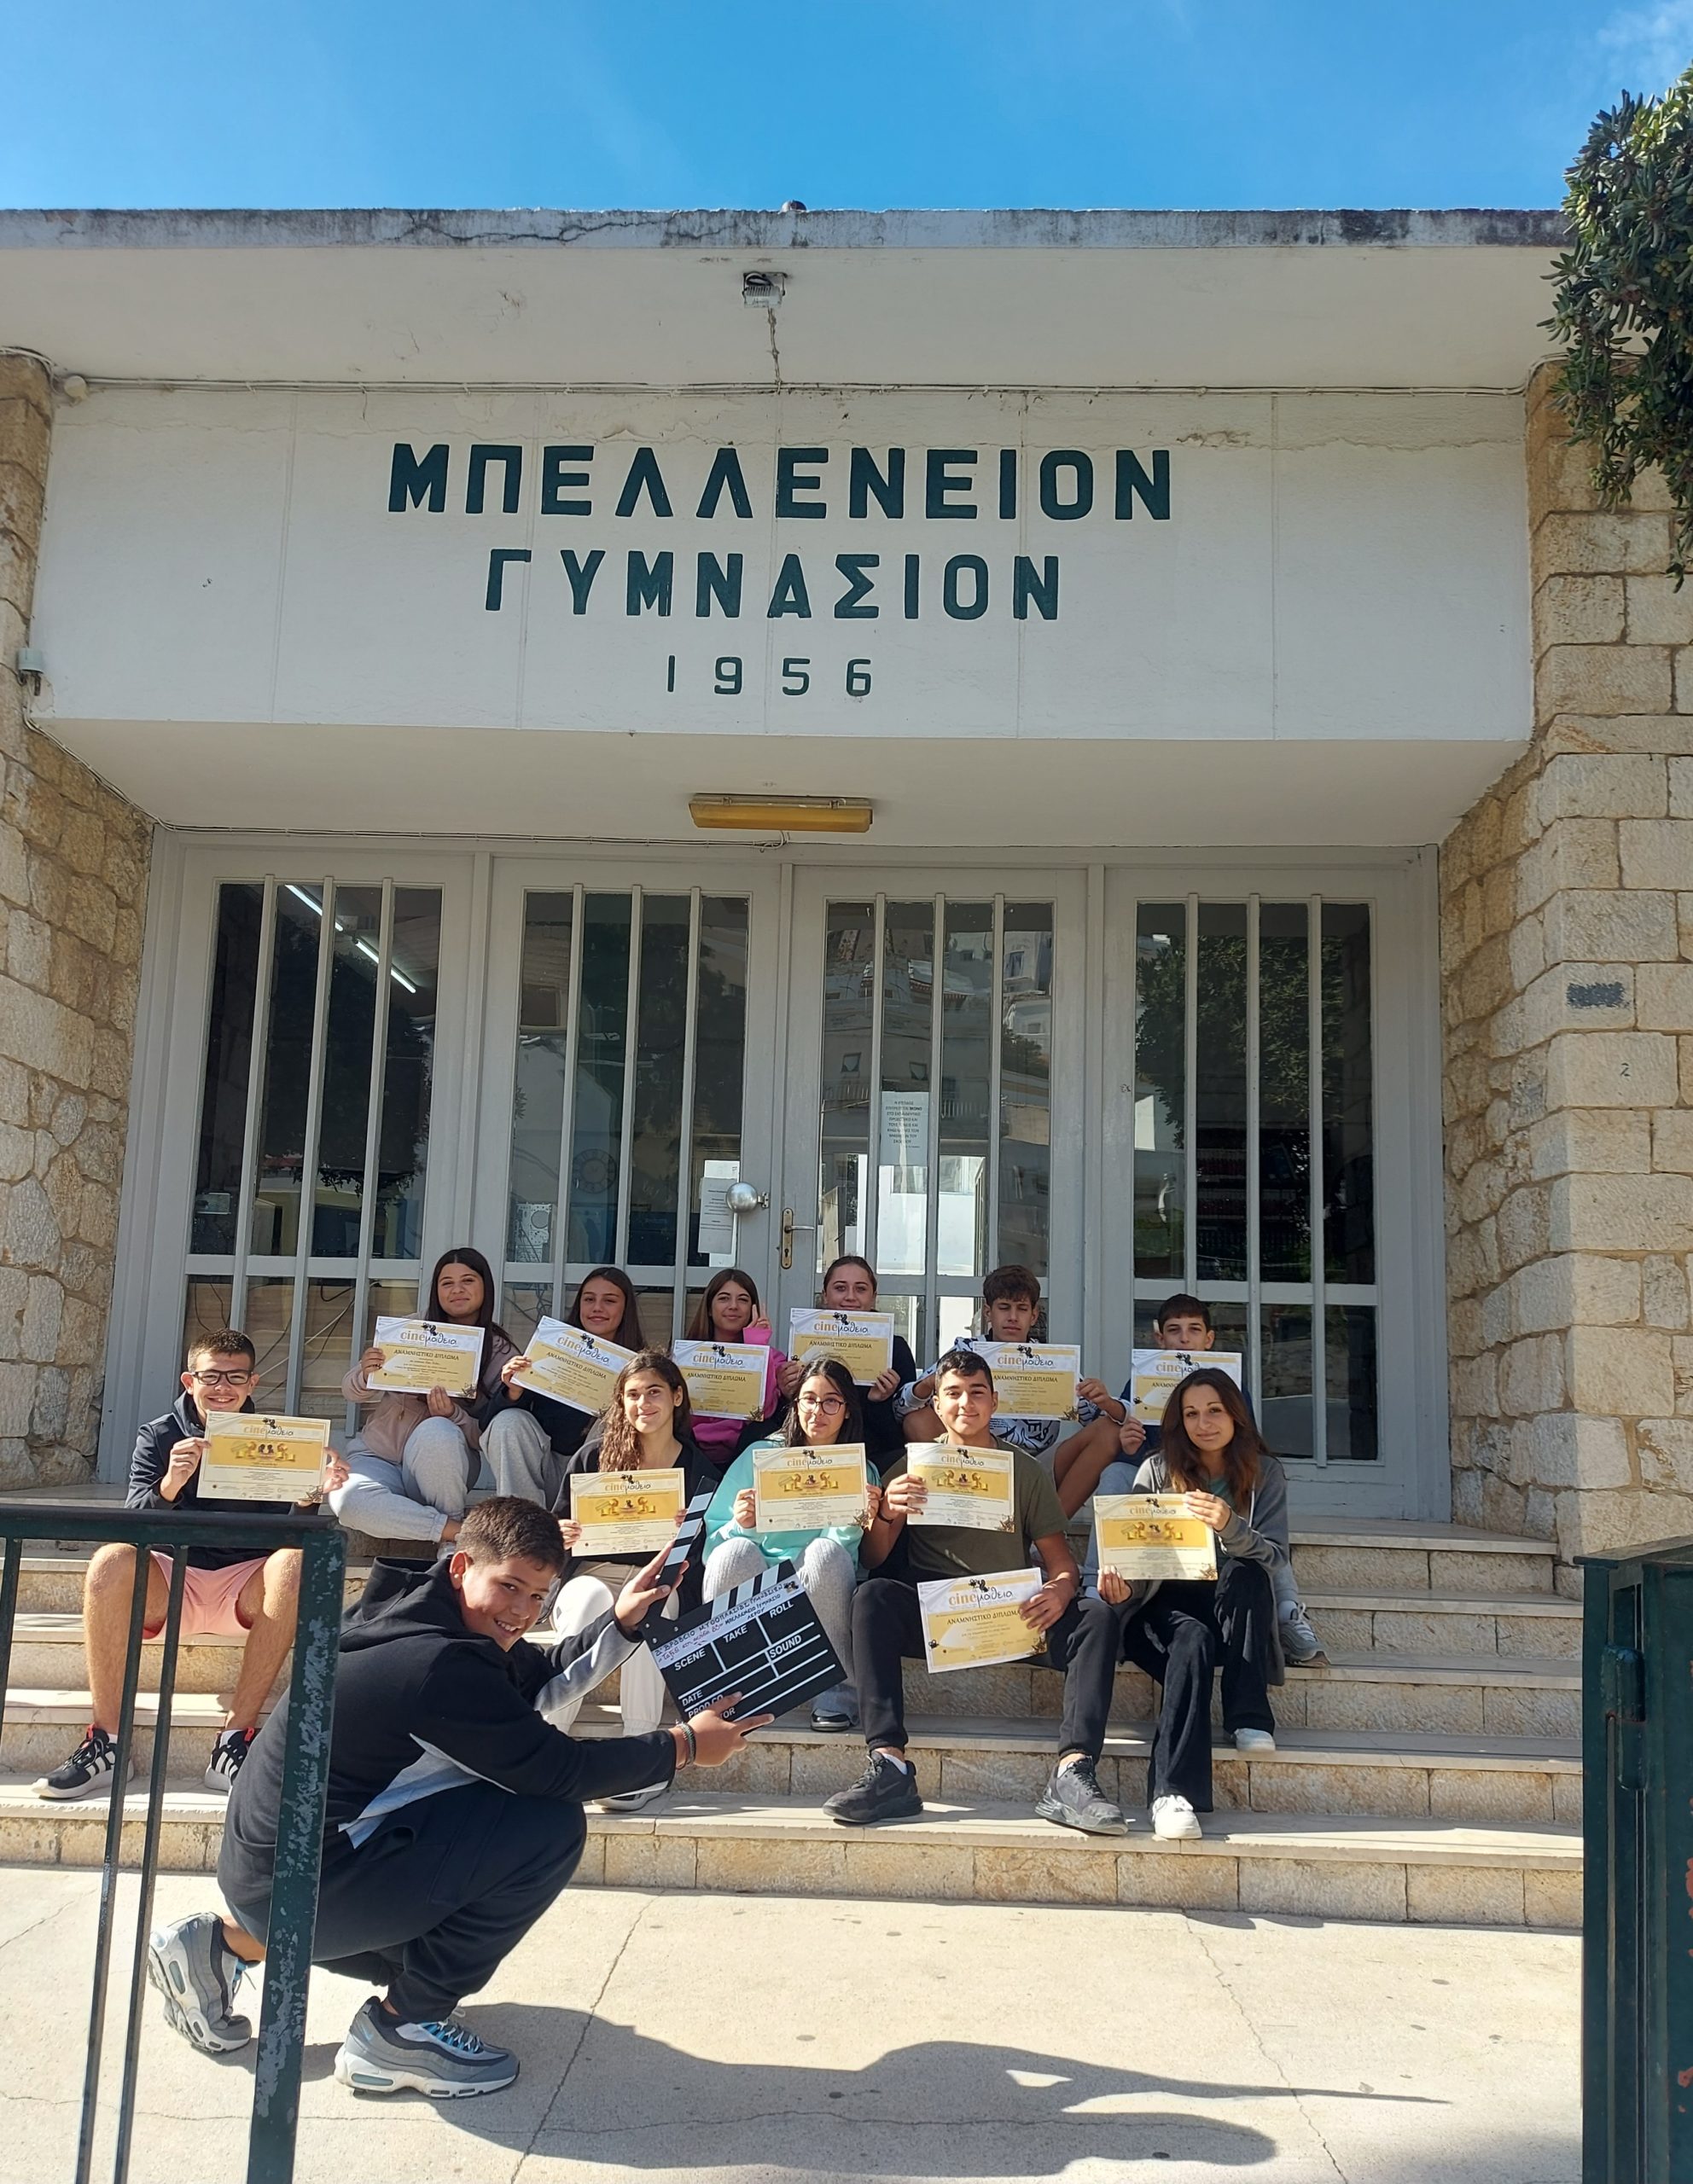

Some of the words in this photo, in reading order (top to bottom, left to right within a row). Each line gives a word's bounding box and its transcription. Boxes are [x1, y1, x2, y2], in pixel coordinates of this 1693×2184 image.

[388, 443, 1171, 520] ΜΠΕΛΛΕΝΕΙΟΝ
[485, 548, 1059, 621] ΓΥΜΝΑΣΙΟΝ
[667, 654, 872, 696] 1956
[770, 1600, 794, 1618] ROLL
[723, 1624, 748, 1643] TAKE
[769, 1635, 802, 1658] SOUND
[674, 1648, 707, 1670] SCENE
[682, 1689, 703, 1706] DATE
